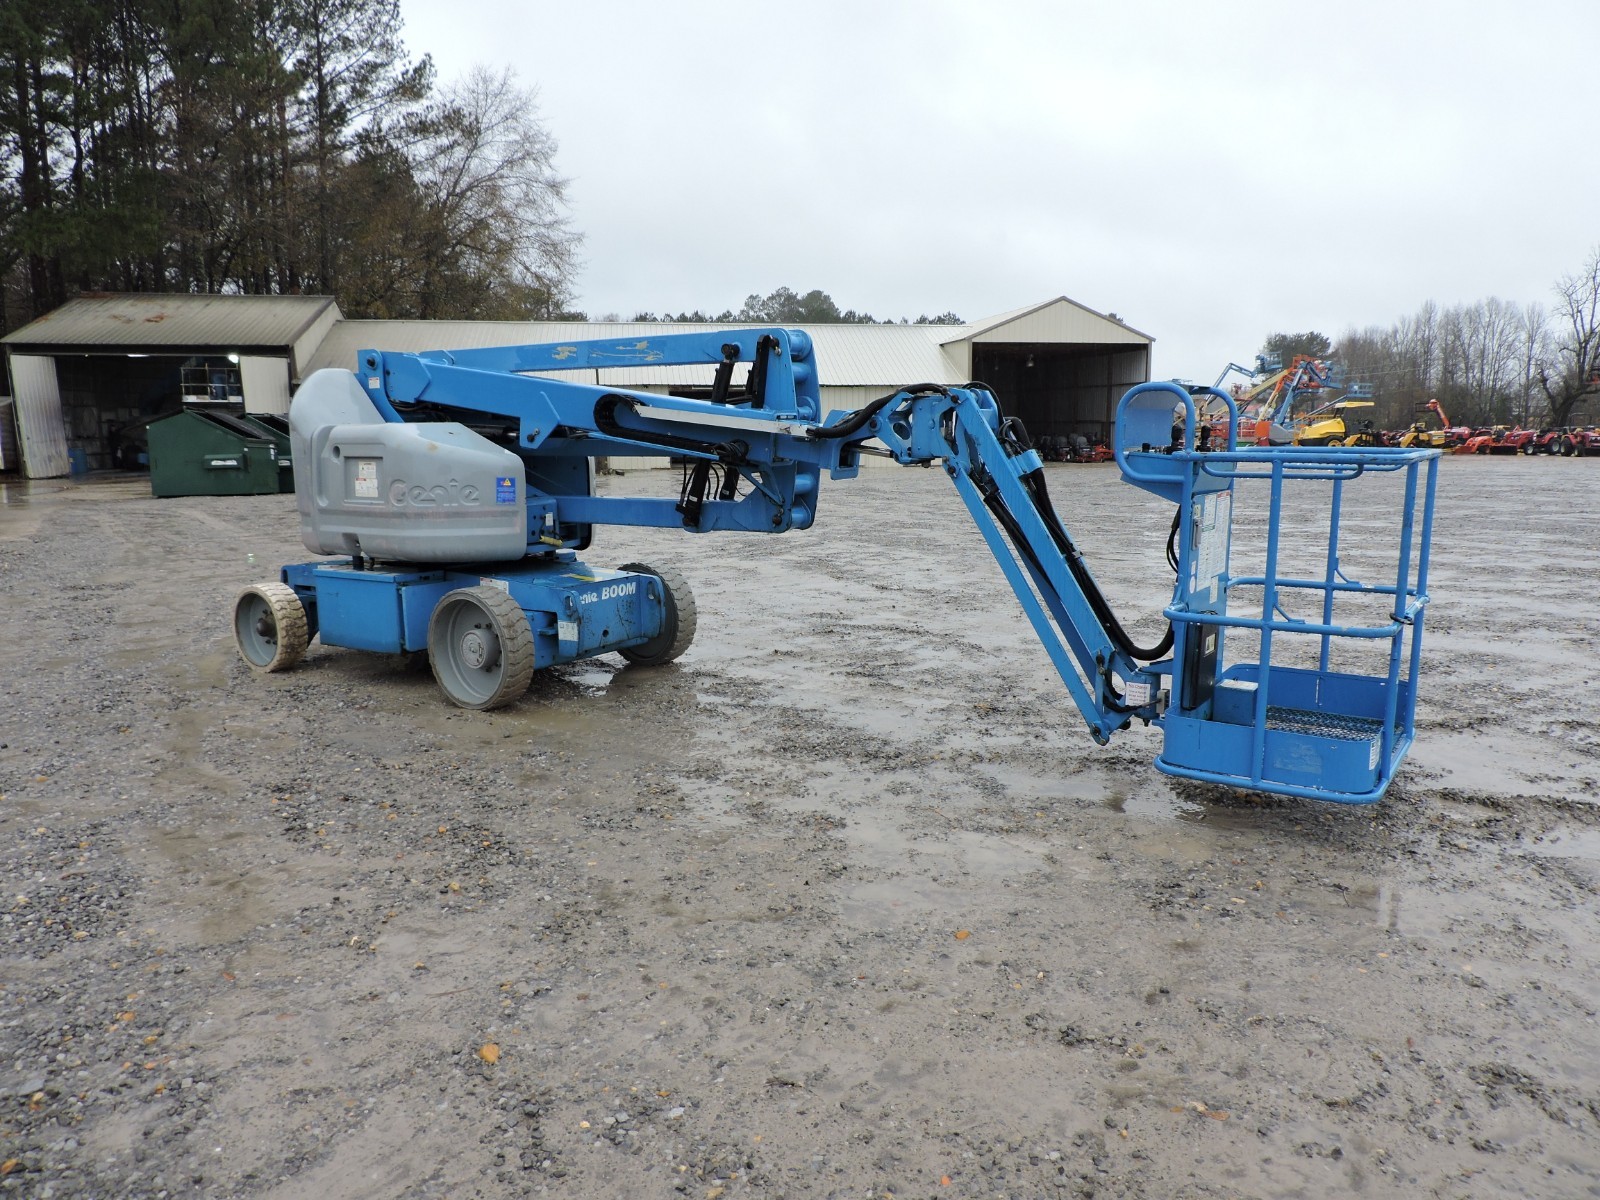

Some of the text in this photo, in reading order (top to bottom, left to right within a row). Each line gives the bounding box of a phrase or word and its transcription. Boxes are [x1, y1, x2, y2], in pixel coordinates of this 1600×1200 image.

[389, 478, 480, 507] Genie
[579, 582, 637, 605] nie BOOM
